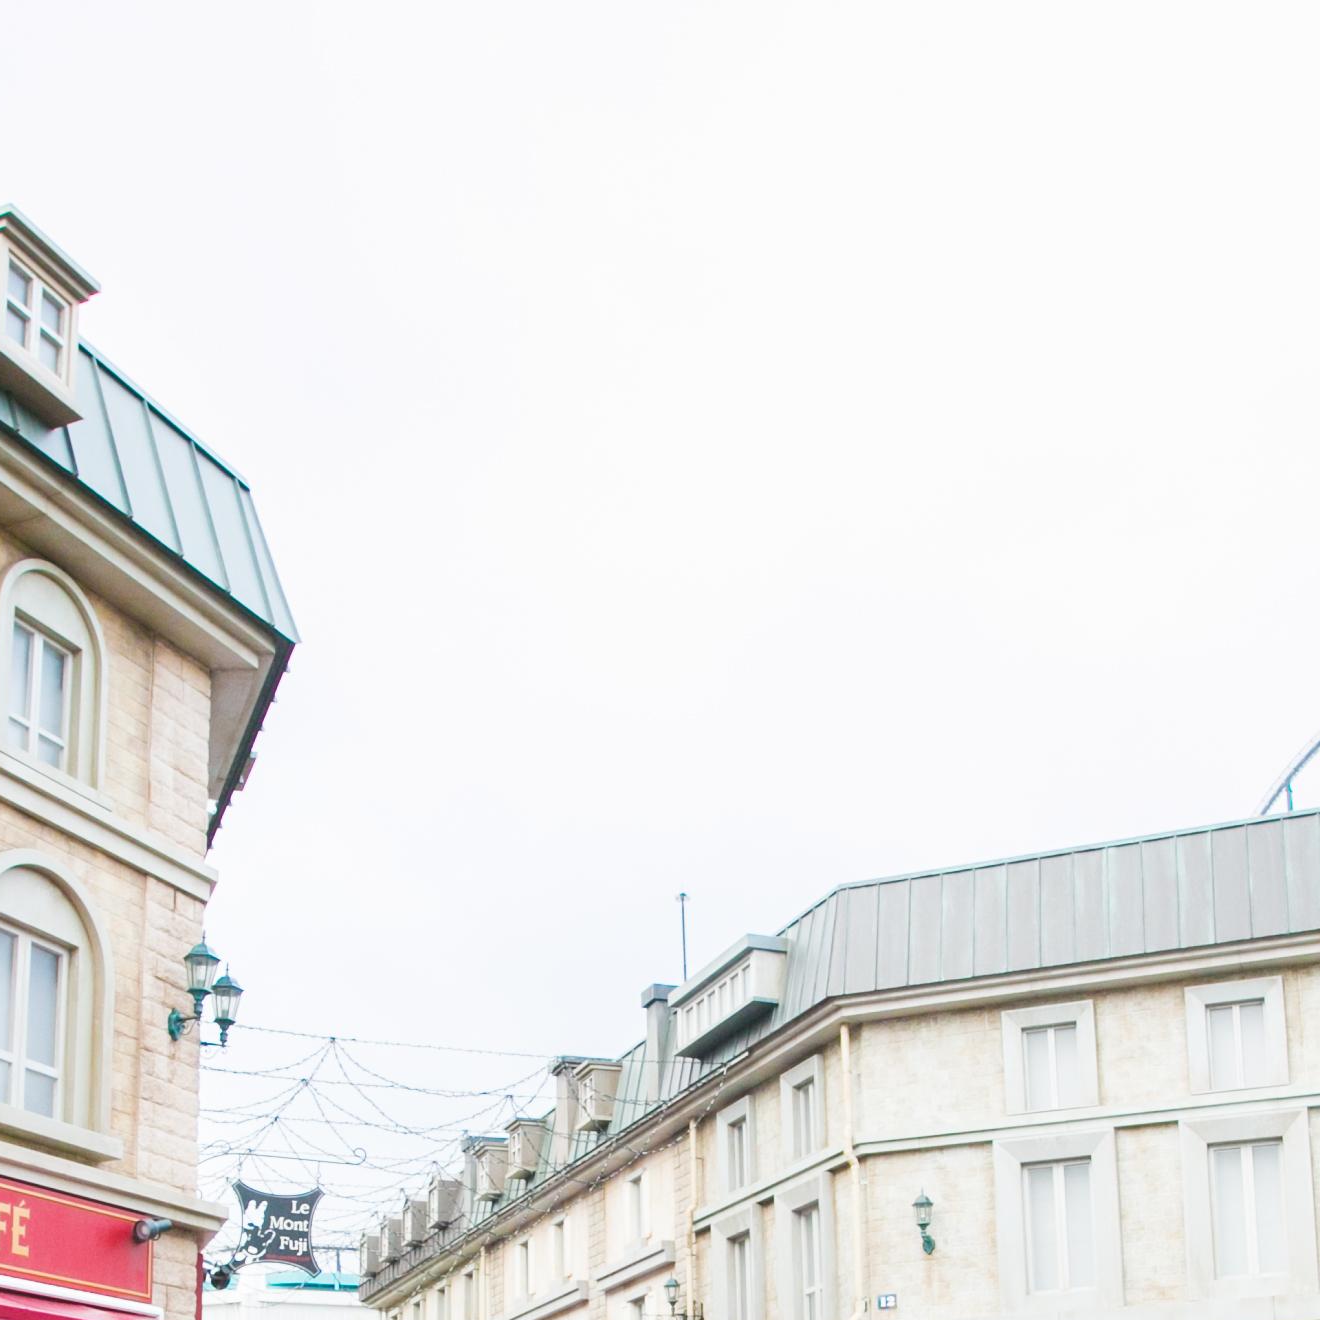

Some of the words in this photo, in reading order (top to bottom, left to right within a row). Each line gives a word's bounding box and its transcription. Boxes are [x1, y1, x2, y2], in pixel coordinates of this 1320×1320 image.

[291, 1200, 310, 1214] Le
[269, 1216, 309, 1232] Mont
[278, 1236, 309, 1256] Fuji
